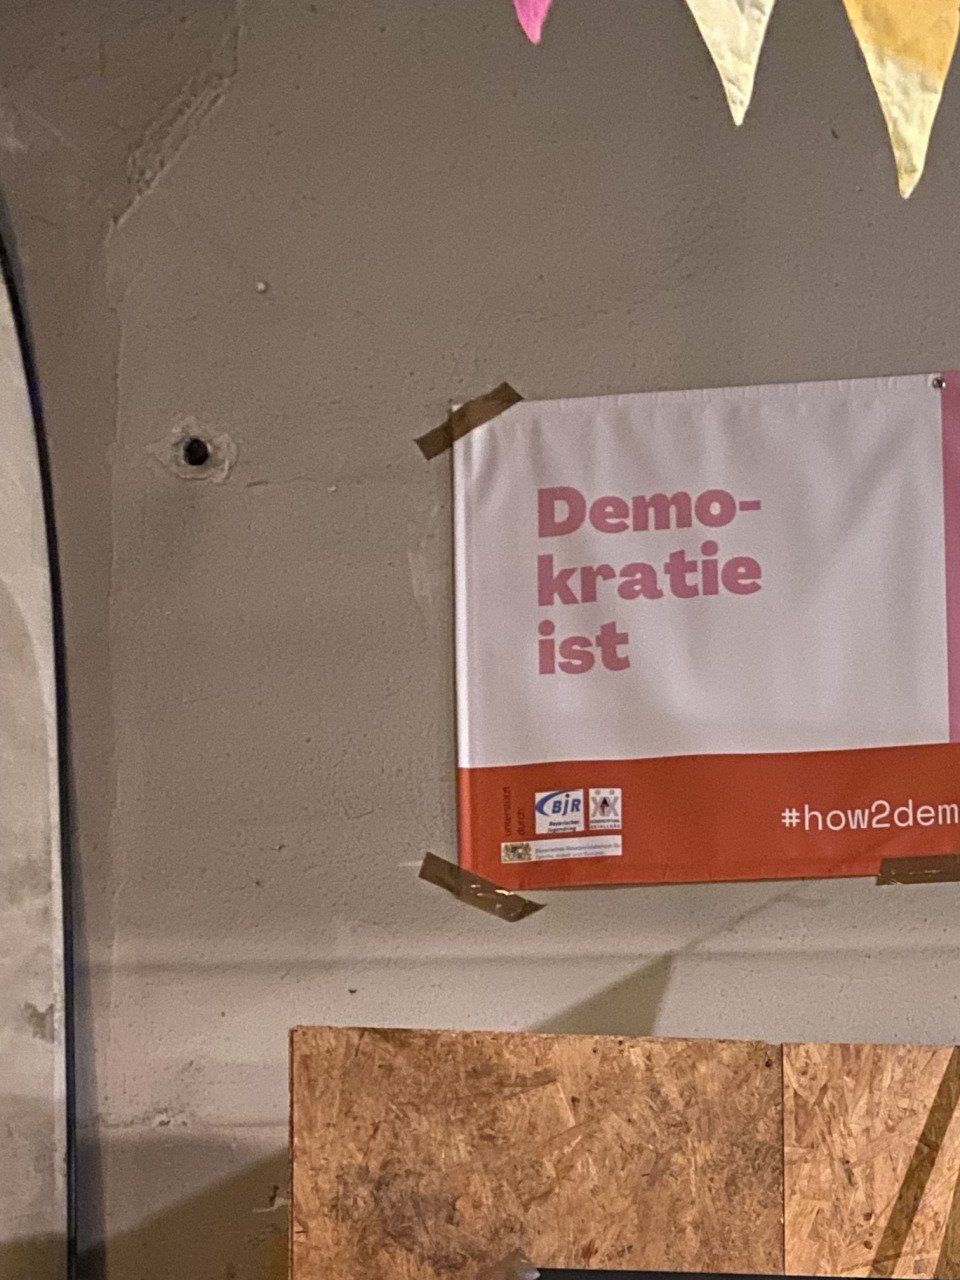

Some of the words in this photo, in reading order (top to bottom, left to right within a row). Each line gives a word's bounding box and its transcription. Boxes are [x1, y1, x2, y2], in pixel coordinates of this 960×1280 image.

[537, 486, 762, 538] Demo-
[537, 541, 763, 606] kratie
[537, 619, 631, 675] ist
